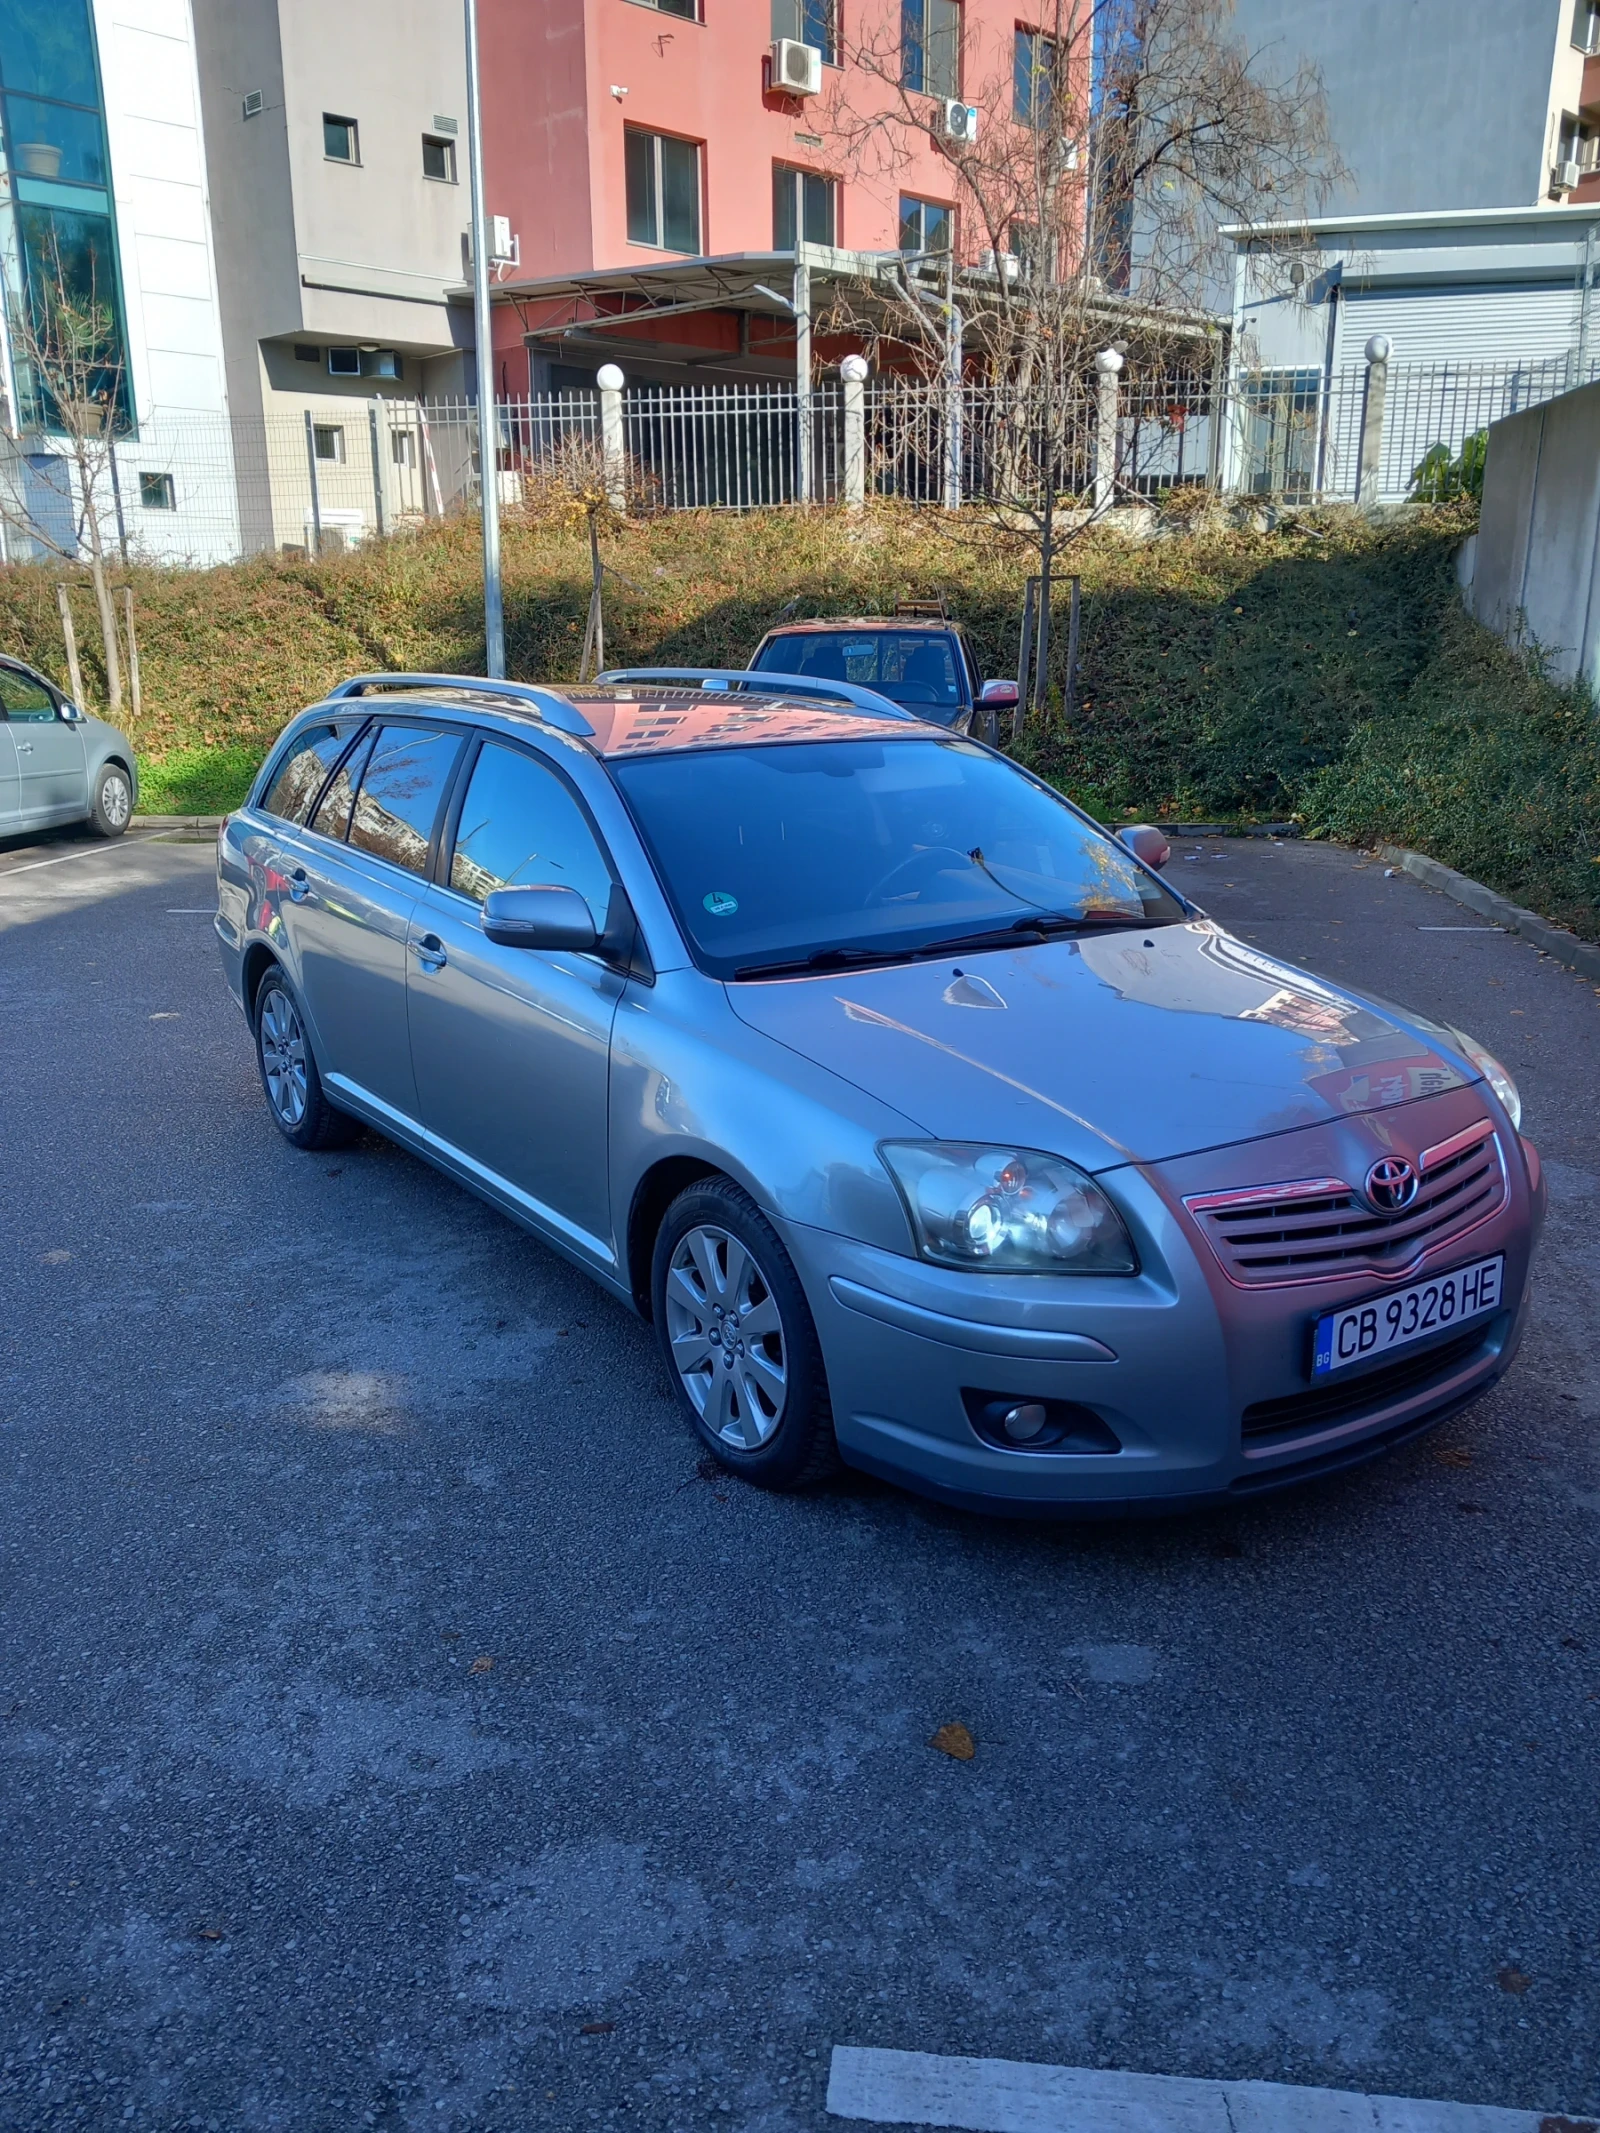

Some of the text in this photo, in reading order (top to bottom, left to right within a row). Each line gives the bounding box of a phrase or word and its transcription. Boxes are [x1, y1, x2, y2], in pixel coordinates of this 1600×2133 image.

[712, 892, 724, 904] 4
[1338, 1264, 1497, 1359] CB 9328 HE
[1316, 1351, 1330, 1367] BG
